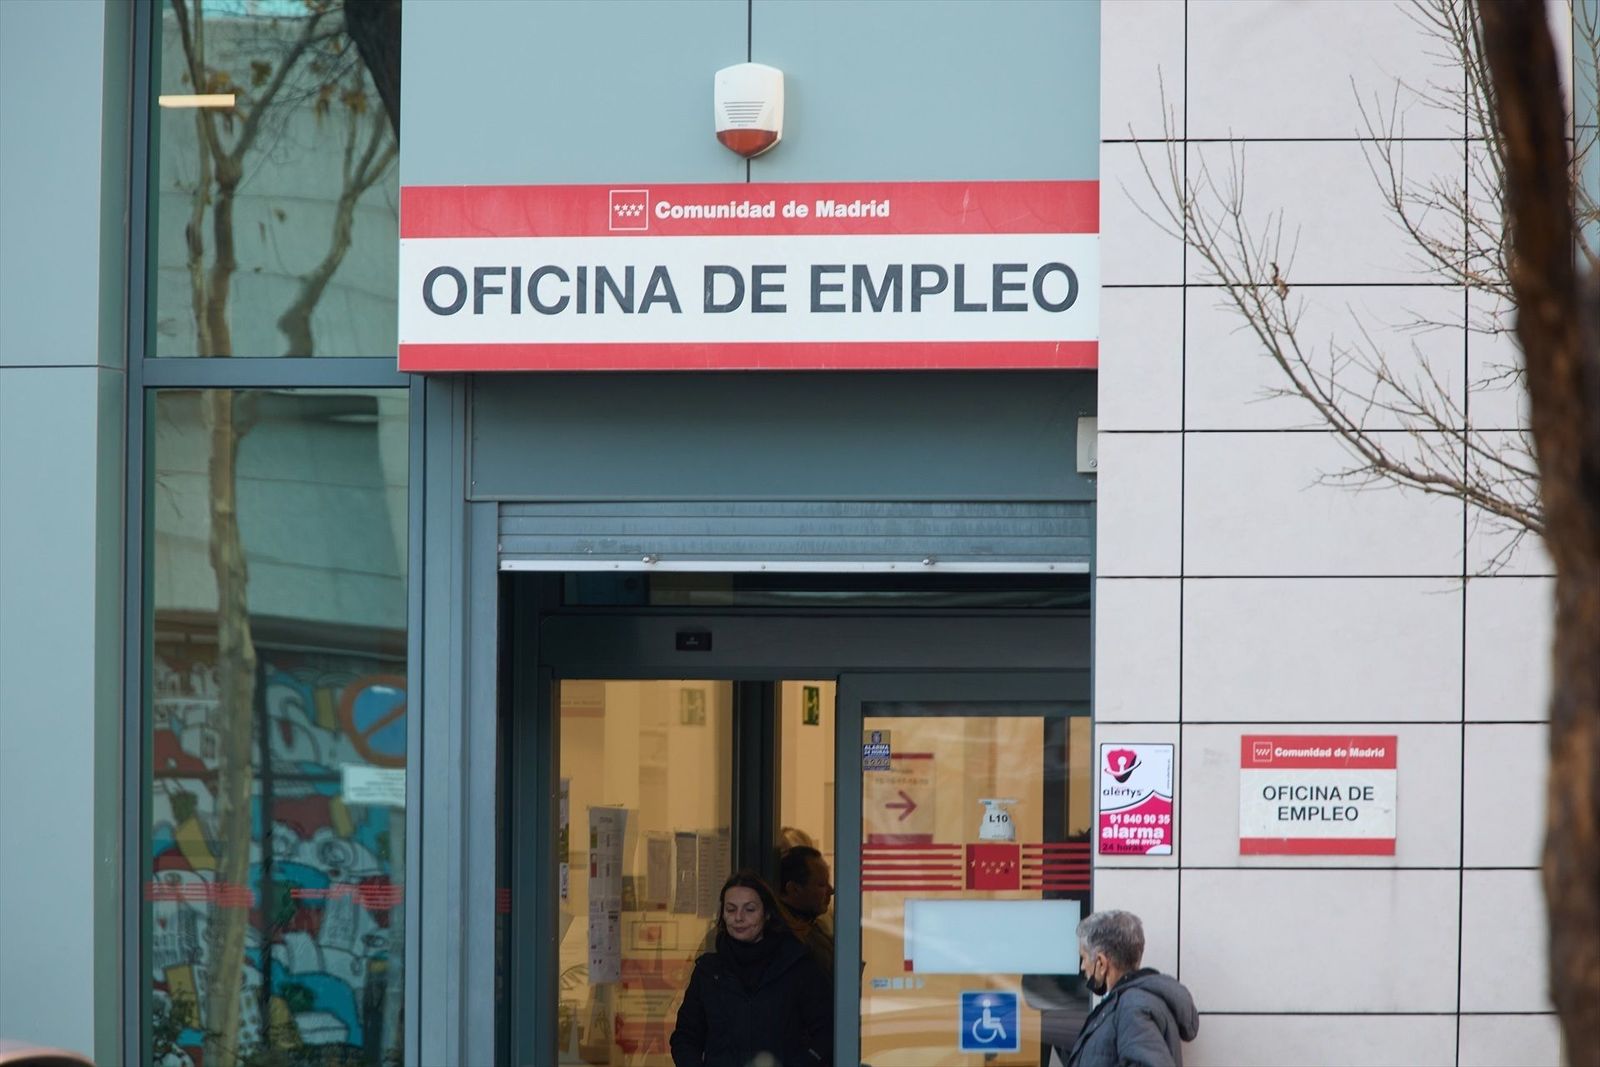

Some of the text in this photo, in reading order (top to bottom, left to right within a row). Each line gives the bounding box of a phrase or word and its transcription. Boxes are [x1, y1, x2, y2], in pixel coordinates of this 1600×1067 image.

[655, 198, 890, 219] Comunidad de Madrid
[422, 261, 1079, 315] OFICINA DE EMPLEO
[1274, 747, 1385, 757] Comunidad de Madrid
[1262, 785, 1375, 801] OFICINA DE
[989, 814, 1008, 823] L10
[1109, 814, 1122, 824] 91
[1278, 806, 1359, 821] EMPLEO
[1102, 823, 1164, 839] alarma
